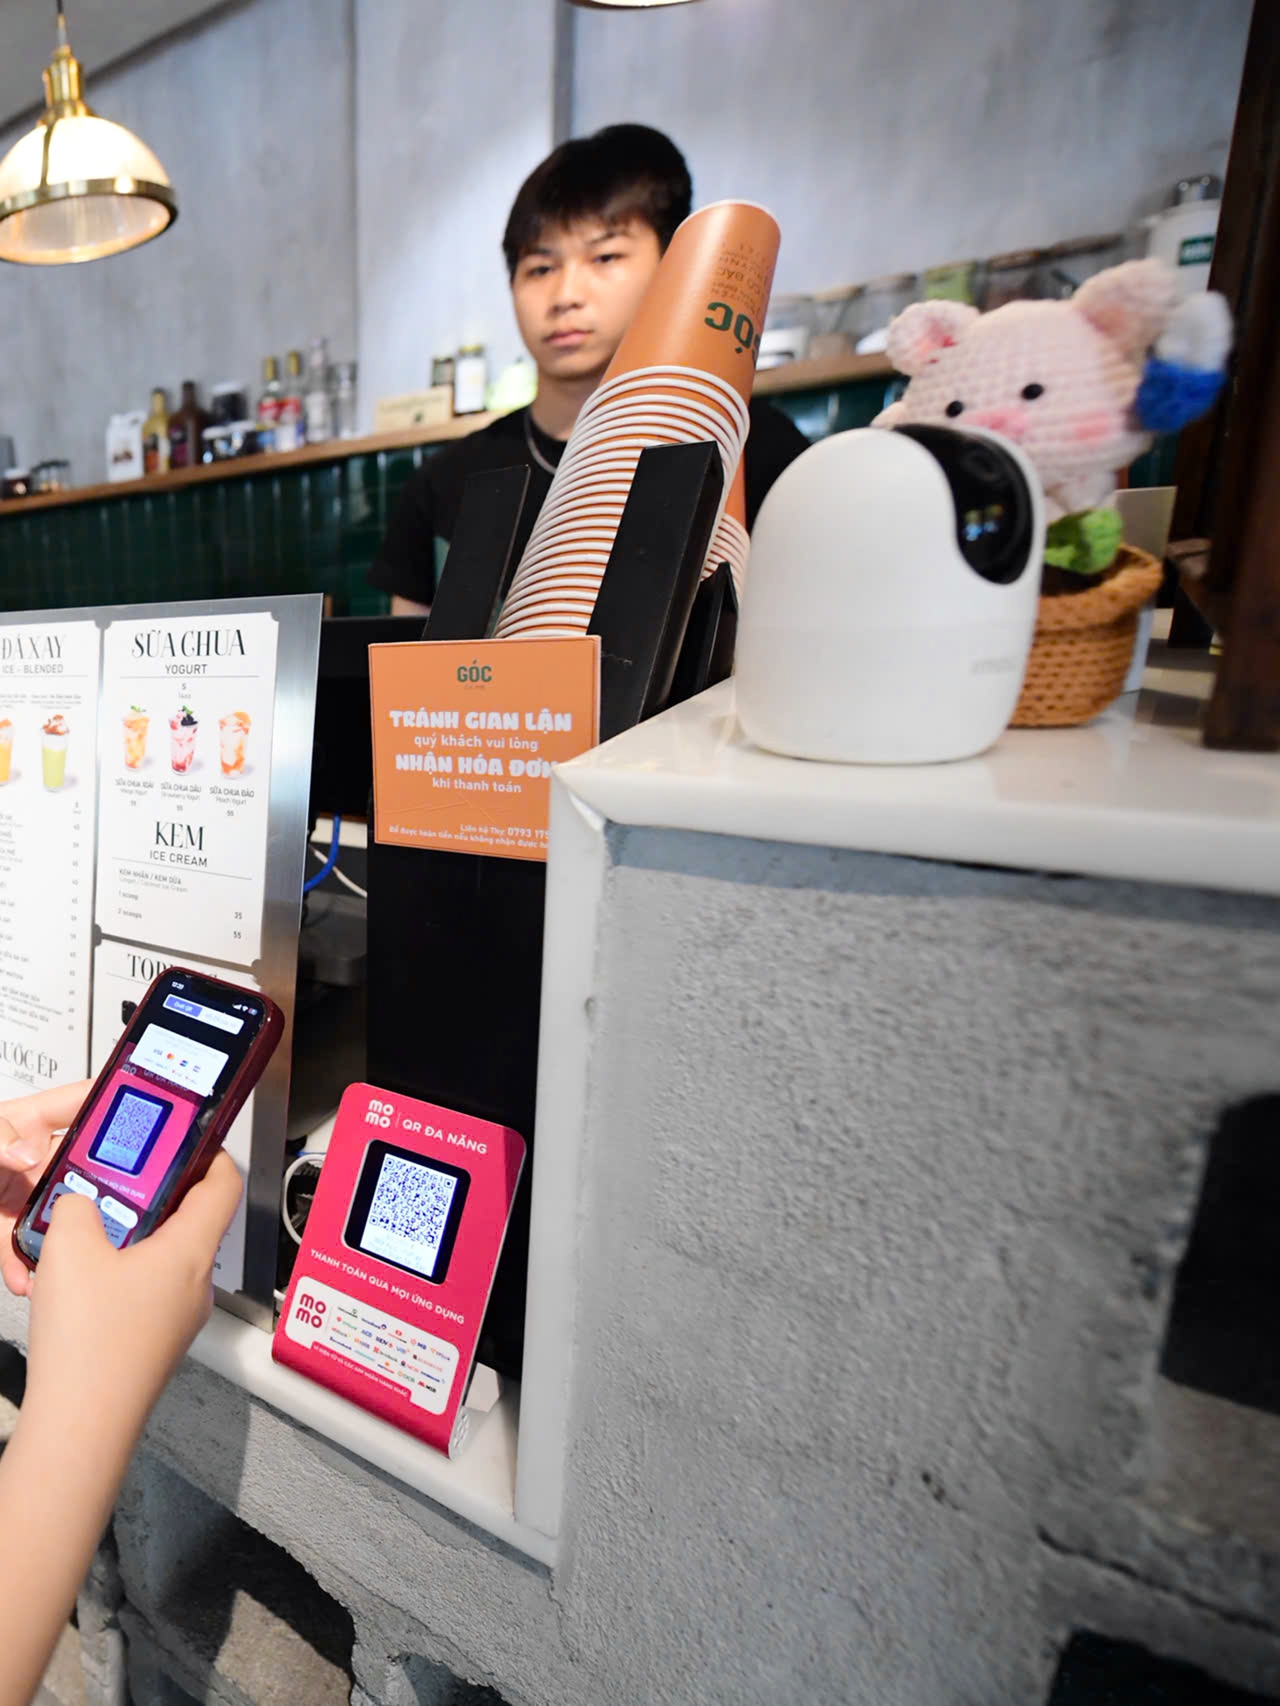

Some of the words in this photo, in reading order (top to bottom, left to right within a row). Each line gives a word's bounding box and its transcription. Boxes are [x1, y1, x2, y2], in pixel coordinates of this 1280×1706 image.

[181, 629, 245, 657] CHUA
[2, 665, 14, 674] ICE
[23, 664, 63, 674] BLENDED
[165, 664, 208, 675] YOGURT
[457, 660, 492, 683] GÓC
[389, 707, 459, 729] TRÁNH
[465, 711, 519, 731] GIAN
[524, 708, 572, 734] LẬN
[414, 733, 437, 749] quý
[441, 734, 482, 749] khách
[486, 736, 505, 749] vui
[509, 736, 539, 752] lòng
[395, 751, 453, 775] NHẬN
[458, 753, 504, 776] HÓA
[173, 783, 188, 792] CHUA
[223, 787, 240, 797] CHUA
[432, 777, 451, 789] khi
[453, 779, 489, 792] thanh
[493, 780, 522, 793] toán
[155, 821, 205, 851] KEM
[507, 827, 532, 837] 0793
[149, 850, 167, 861] ICE
[169, 852, 208, 867] CREAM
[37, 1052, 58, 1079] ÉP
[403, 1119, 421, 1133] QR
[425, 1126, 443, 1140] ĐA
[448, 1132, 487, 1154] NĂNG
[310, 1249, 340, 1268] THANH
[341, 1263, 367, 1280] TOÁN
[369, 1275, 389, 1290] QUA
[390, 1285, 410, 1300] MỌI
[411, 1292, 433, 1310] ỨNG
[435, 1305, 464, 1324] DỤNG
